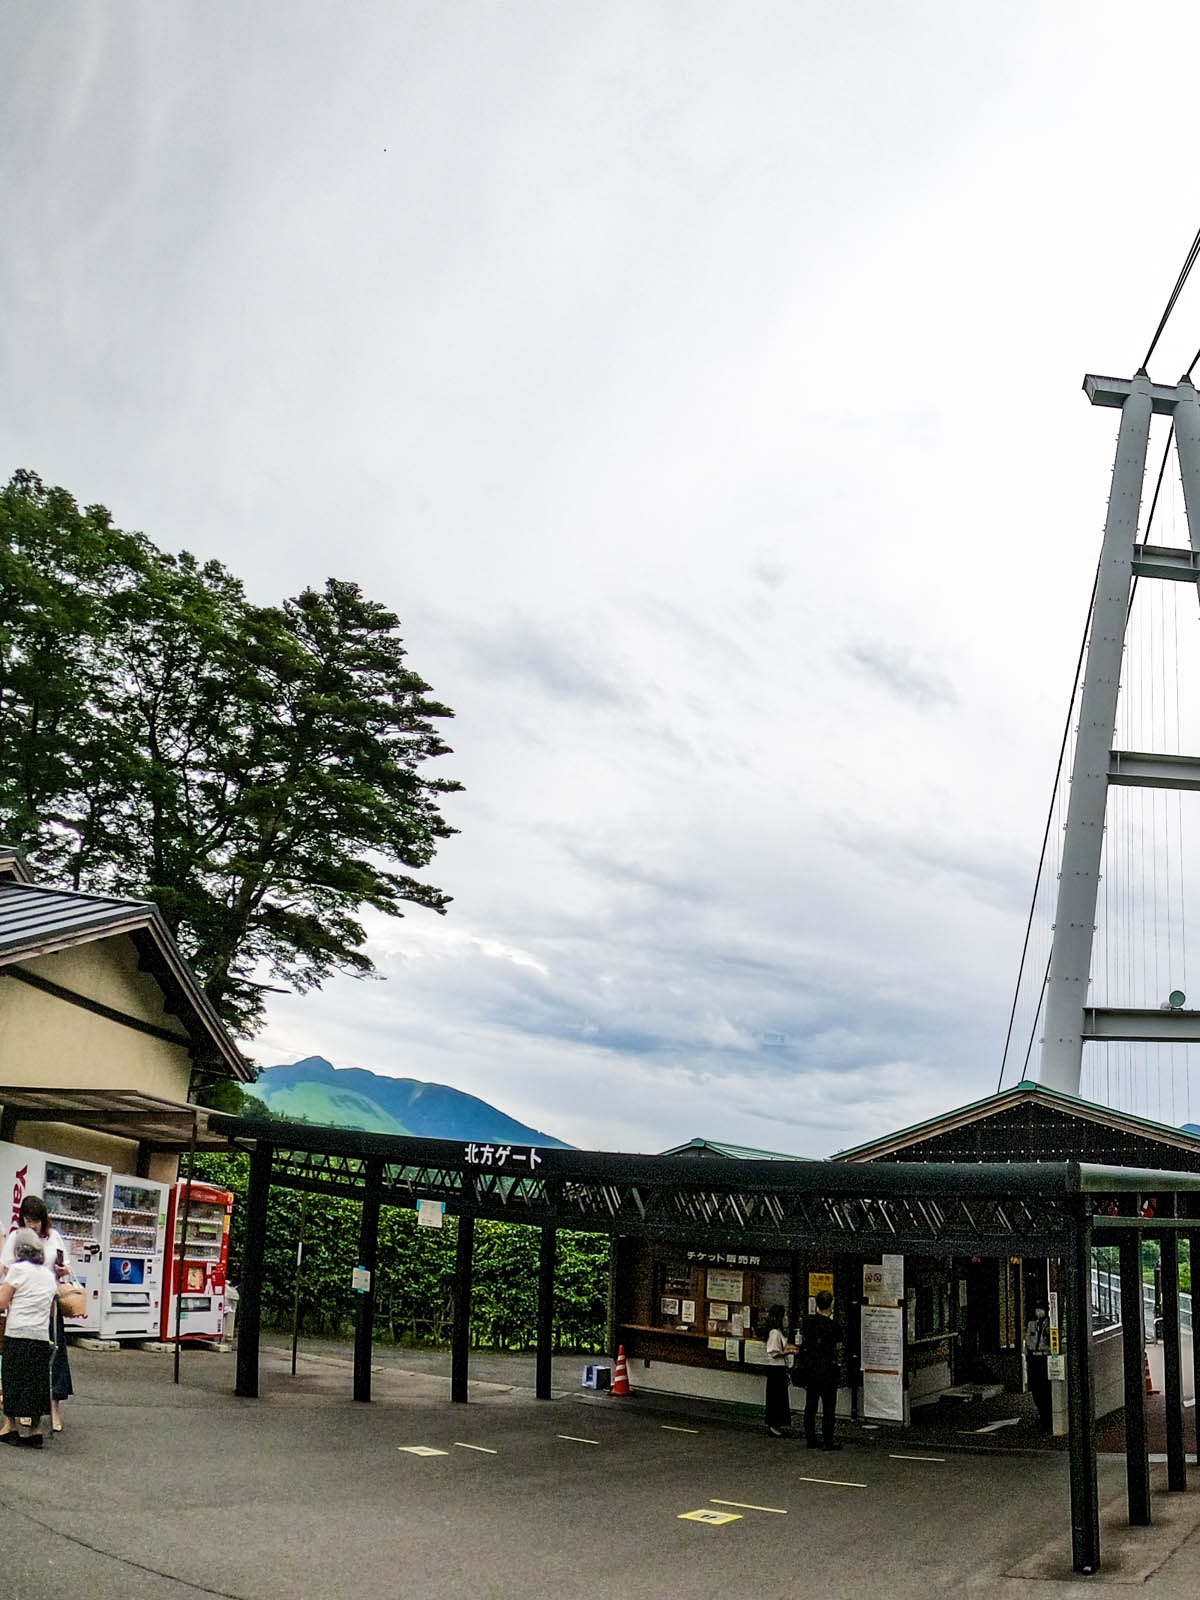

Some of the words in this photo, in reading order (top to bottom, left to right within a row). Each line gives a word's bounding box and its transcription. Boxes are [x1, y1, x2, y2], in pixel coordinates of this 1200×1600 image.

[464, 1143, 542, 1170] 北方ゲート
[687, 1251, 761, 1266] チケット販売所
